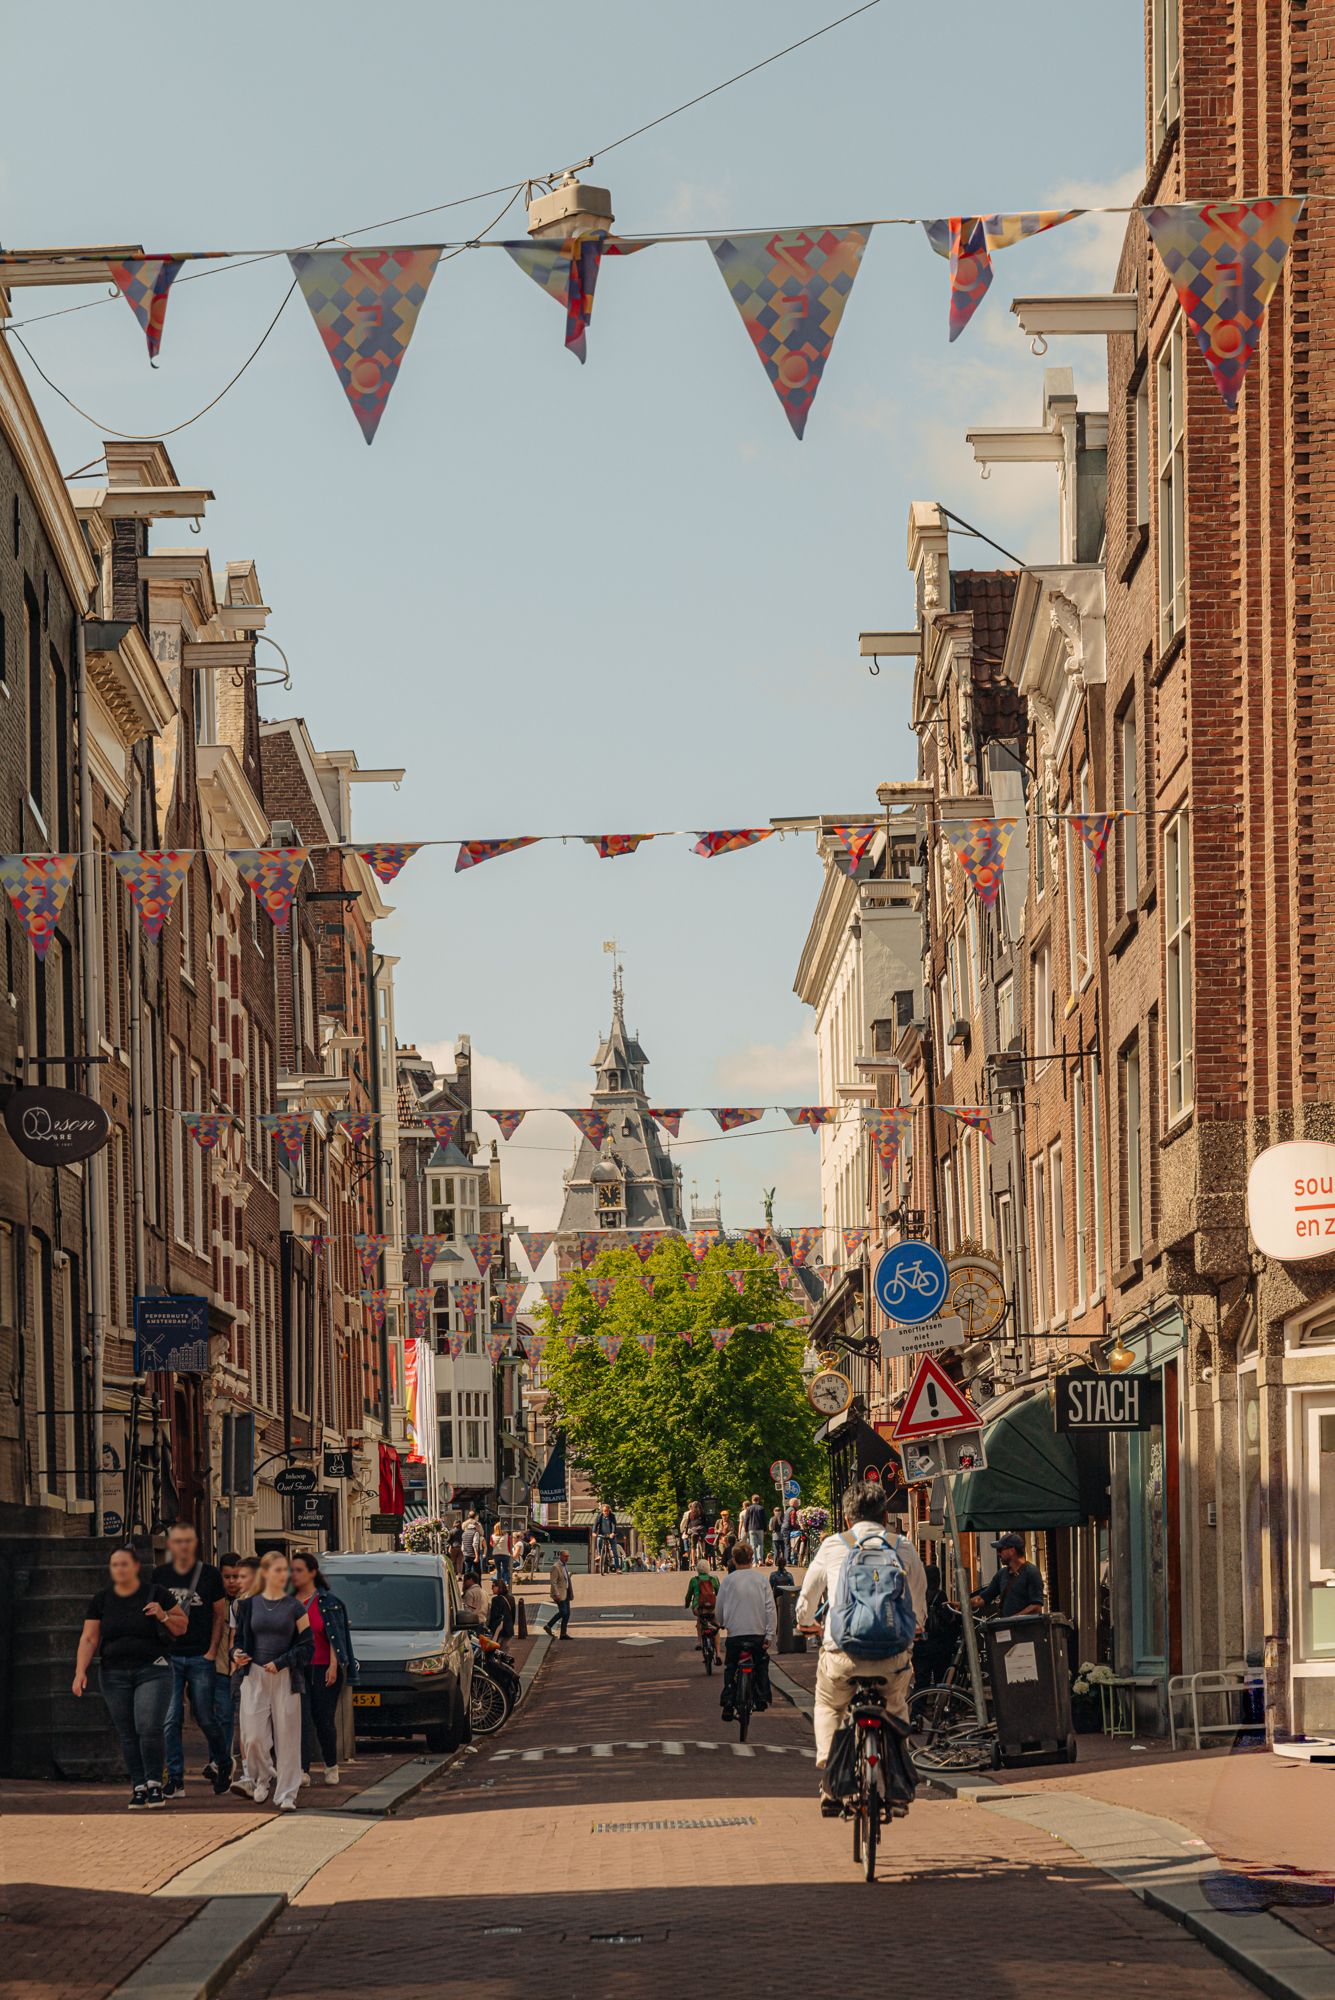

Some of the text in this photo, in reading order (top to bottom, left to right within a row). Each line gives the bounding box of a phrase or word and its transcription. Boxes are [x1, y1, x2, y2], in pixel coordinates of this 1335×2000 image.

[1294, 1176, 1333, 1196] sou
[1296, 1219, 1320, 1237] en
[898, 1322, 943, 1336] snorfietsen
[914, 1333, 930, 1341] niet
[901, 1339, 945, 1352] toegestaan
[1068, 1380, 1139, 1422] STACH
[276, 1481, 294, 1491] Oud
